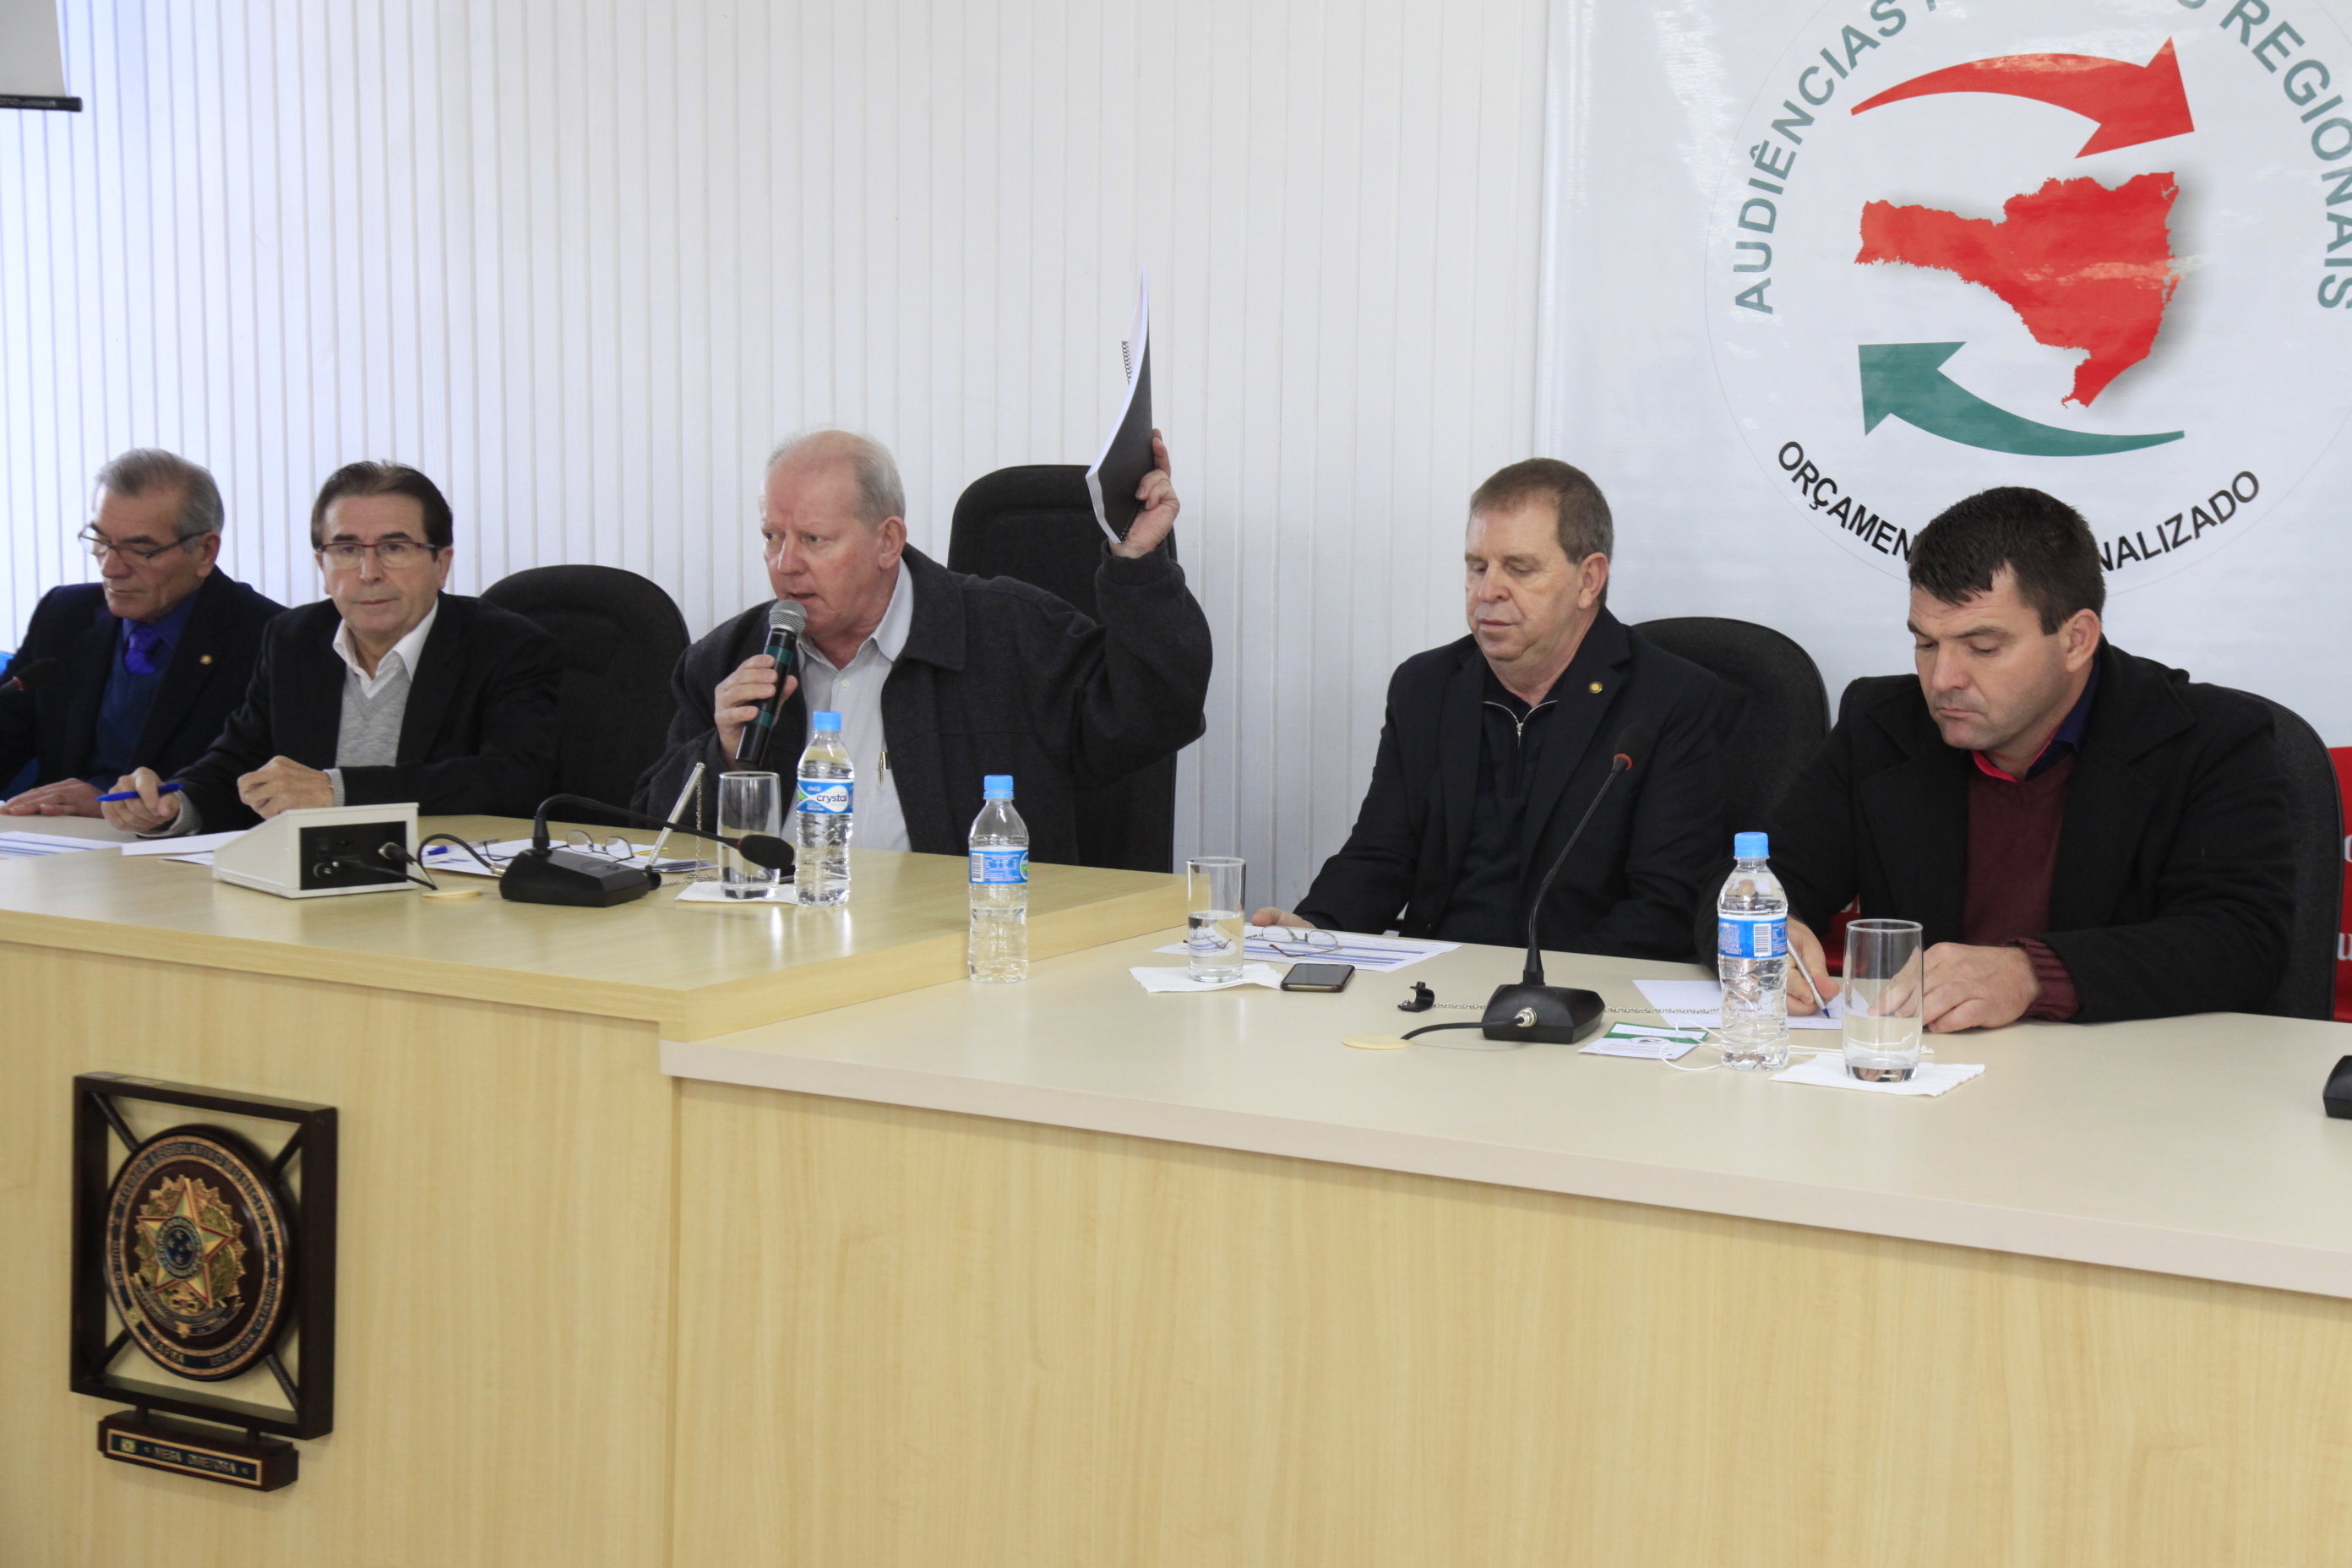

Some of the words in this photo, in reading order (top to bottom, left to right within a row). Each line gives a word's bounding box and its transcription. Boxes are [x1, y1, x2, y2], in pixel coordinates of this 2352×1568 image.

[1734, 0, 1906, 314] AUDIÊNCIAS
[2220, 0, 2352, 308] REGIONAIS
[1778, 441, 1916, 562] ORÇAMEN
[2101, 471, 2259, 571] NALIZADO
[816, 793, 847, 803] crystal
